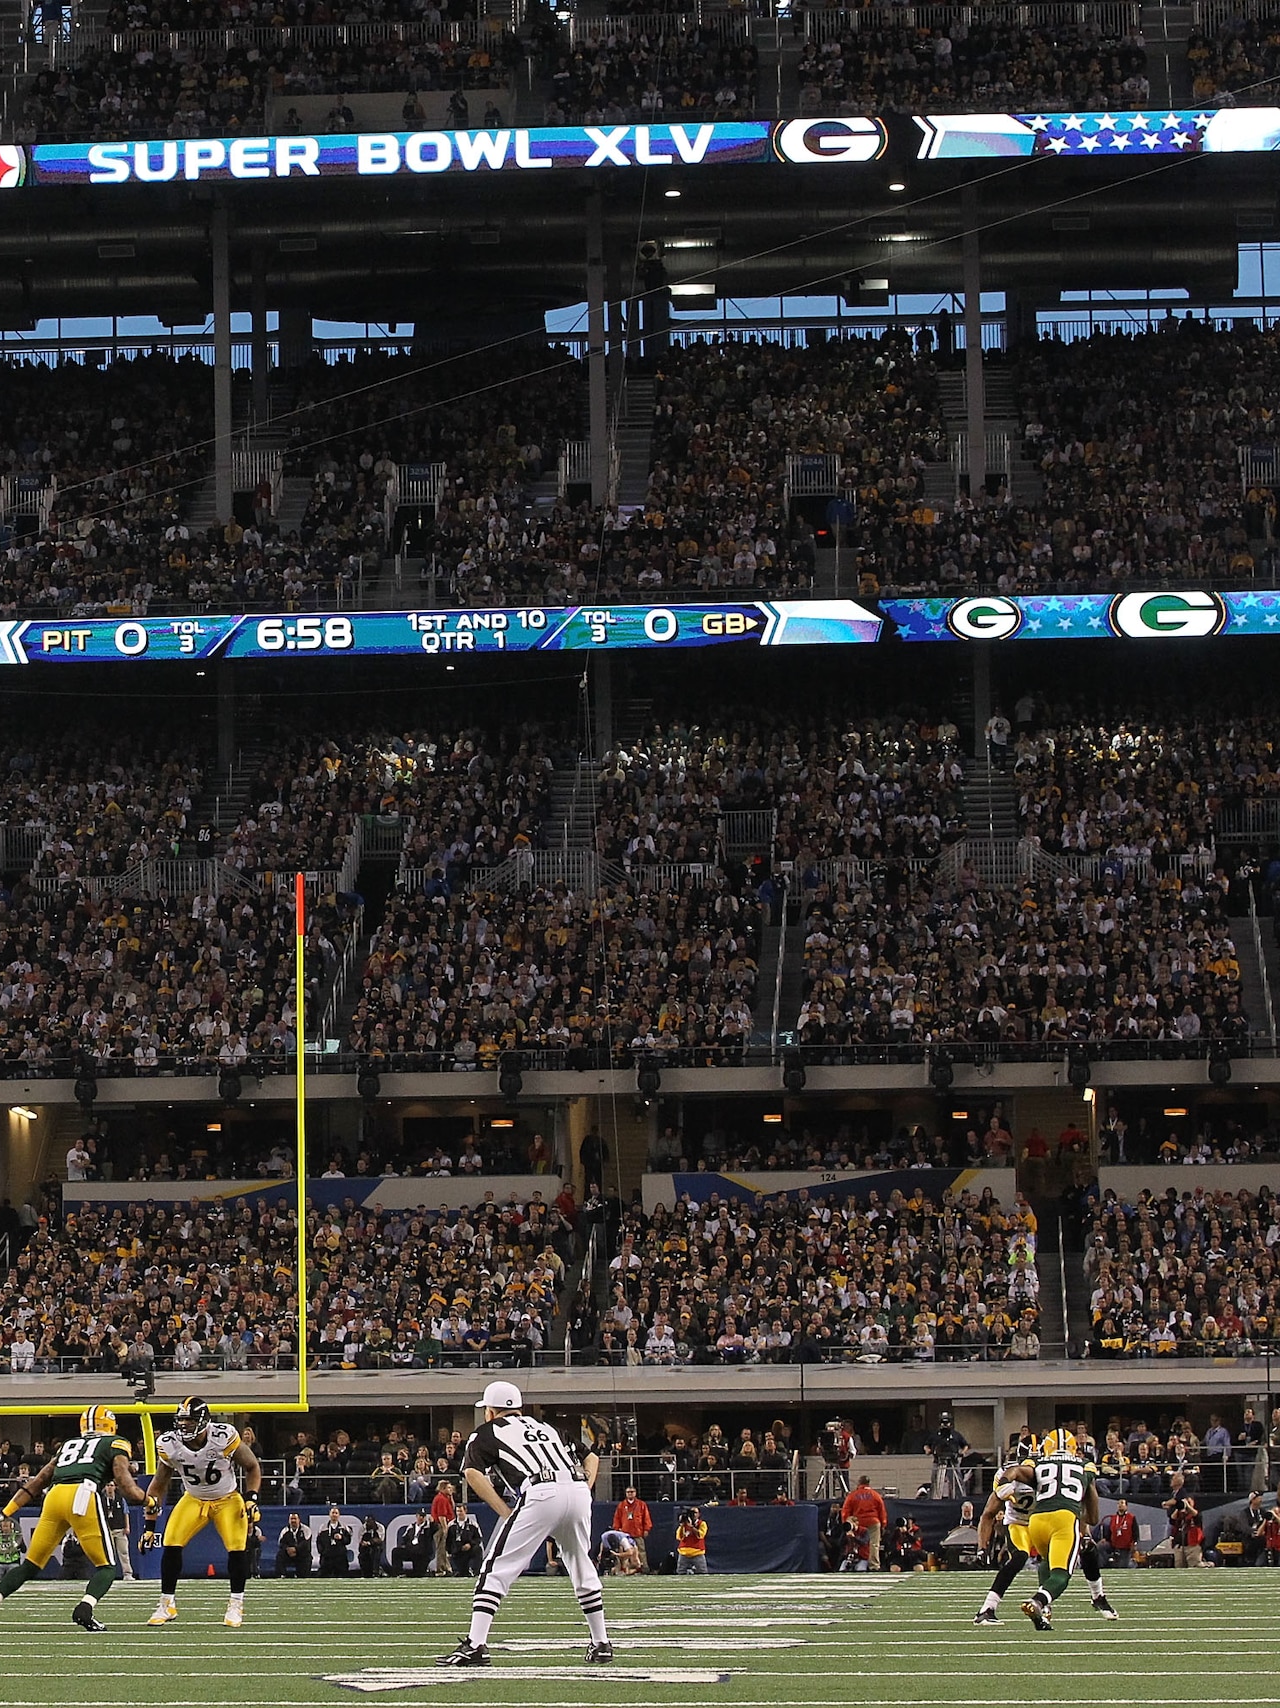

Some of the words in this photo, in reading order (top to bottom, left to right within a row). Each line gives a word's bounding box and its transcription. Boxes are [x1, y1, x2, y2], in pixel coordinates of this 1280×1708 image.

[88, 138, 322, 184] SUPER
[357, 129, 553, 175] BOWL
[583, 124, 714, 168] XLV
[407, 614, 448, 632] 1ST
[456, 613, 508, 631] AND
[517, 610, 546, 629] 10
[581, 610, 616, 625] TOL
[643, 607, 677, 641] 0
[700, 613, 746, 636] GB
[43, 630, 92, 652] PIT
[115, 621, 149, 656] 0
[170, 621, 204, 637] TOL
[179, 635, 194, 652] 3
[257, 617, 355, 651] 6:58
[421, 632, 476, 654] QTR
[493, 632, 506, 649] 1
[589, 624, 606, 642] 3
[198, 828, 211, 842] 86
[821, 1173, 836, 1182] 124
[211, 1423, 228, 1439] 56
[523, 1430, 550, 1442] 66
[56, 1438, 102, 1468] 81
[183, 1460, 221, 1486] 56
[1035, 1462, 1084, 1502] 85
